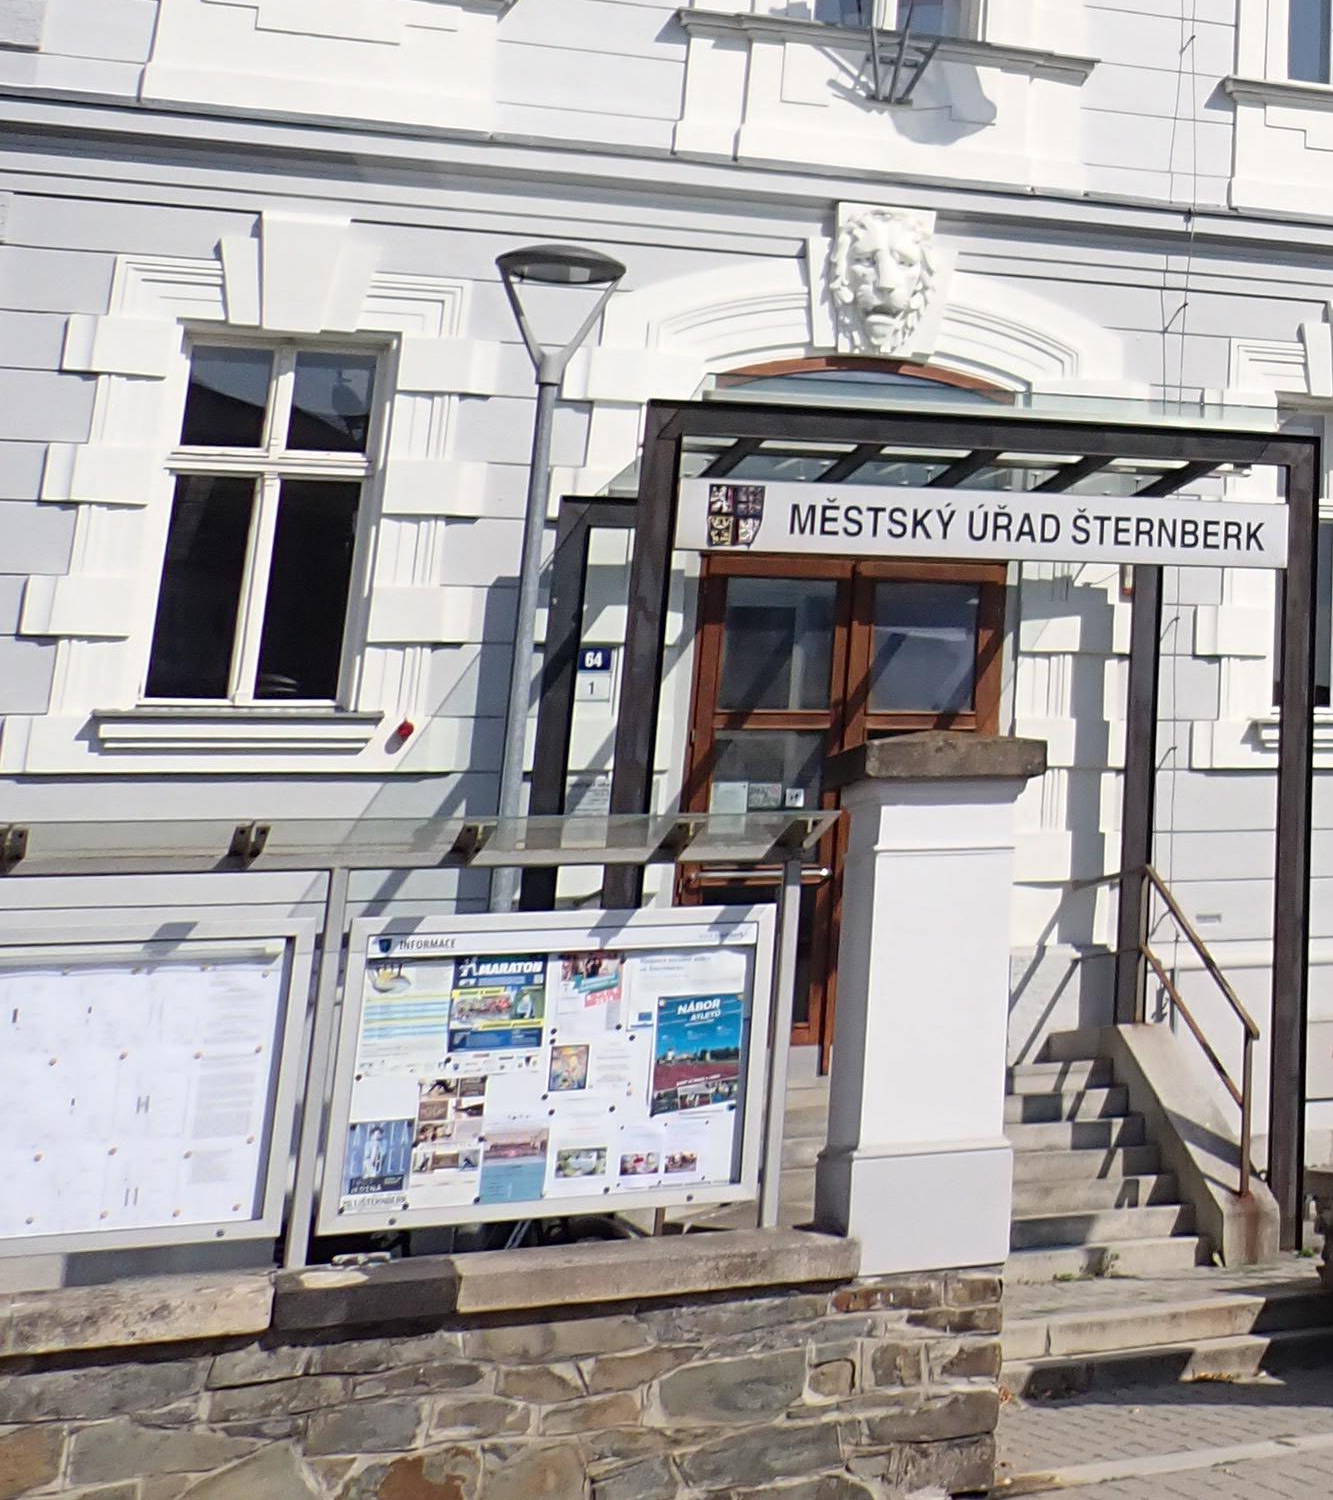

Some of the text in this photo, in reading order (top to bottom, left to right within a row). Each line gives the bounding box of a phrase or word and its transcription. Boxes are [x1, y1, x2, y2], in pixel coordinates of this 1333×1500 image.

[789, 499, 1265, 552] MĚSTSKÝ ÚŘAD ŠTERNBERK
[584, 651, 603, 668] 64
[588, 681, 595, 695] 1
[400, 938, 456, 950] INFORMACE
[478, 961, 543, 975] MARATON
[677, 998, 721, 1015] NÁBOR
